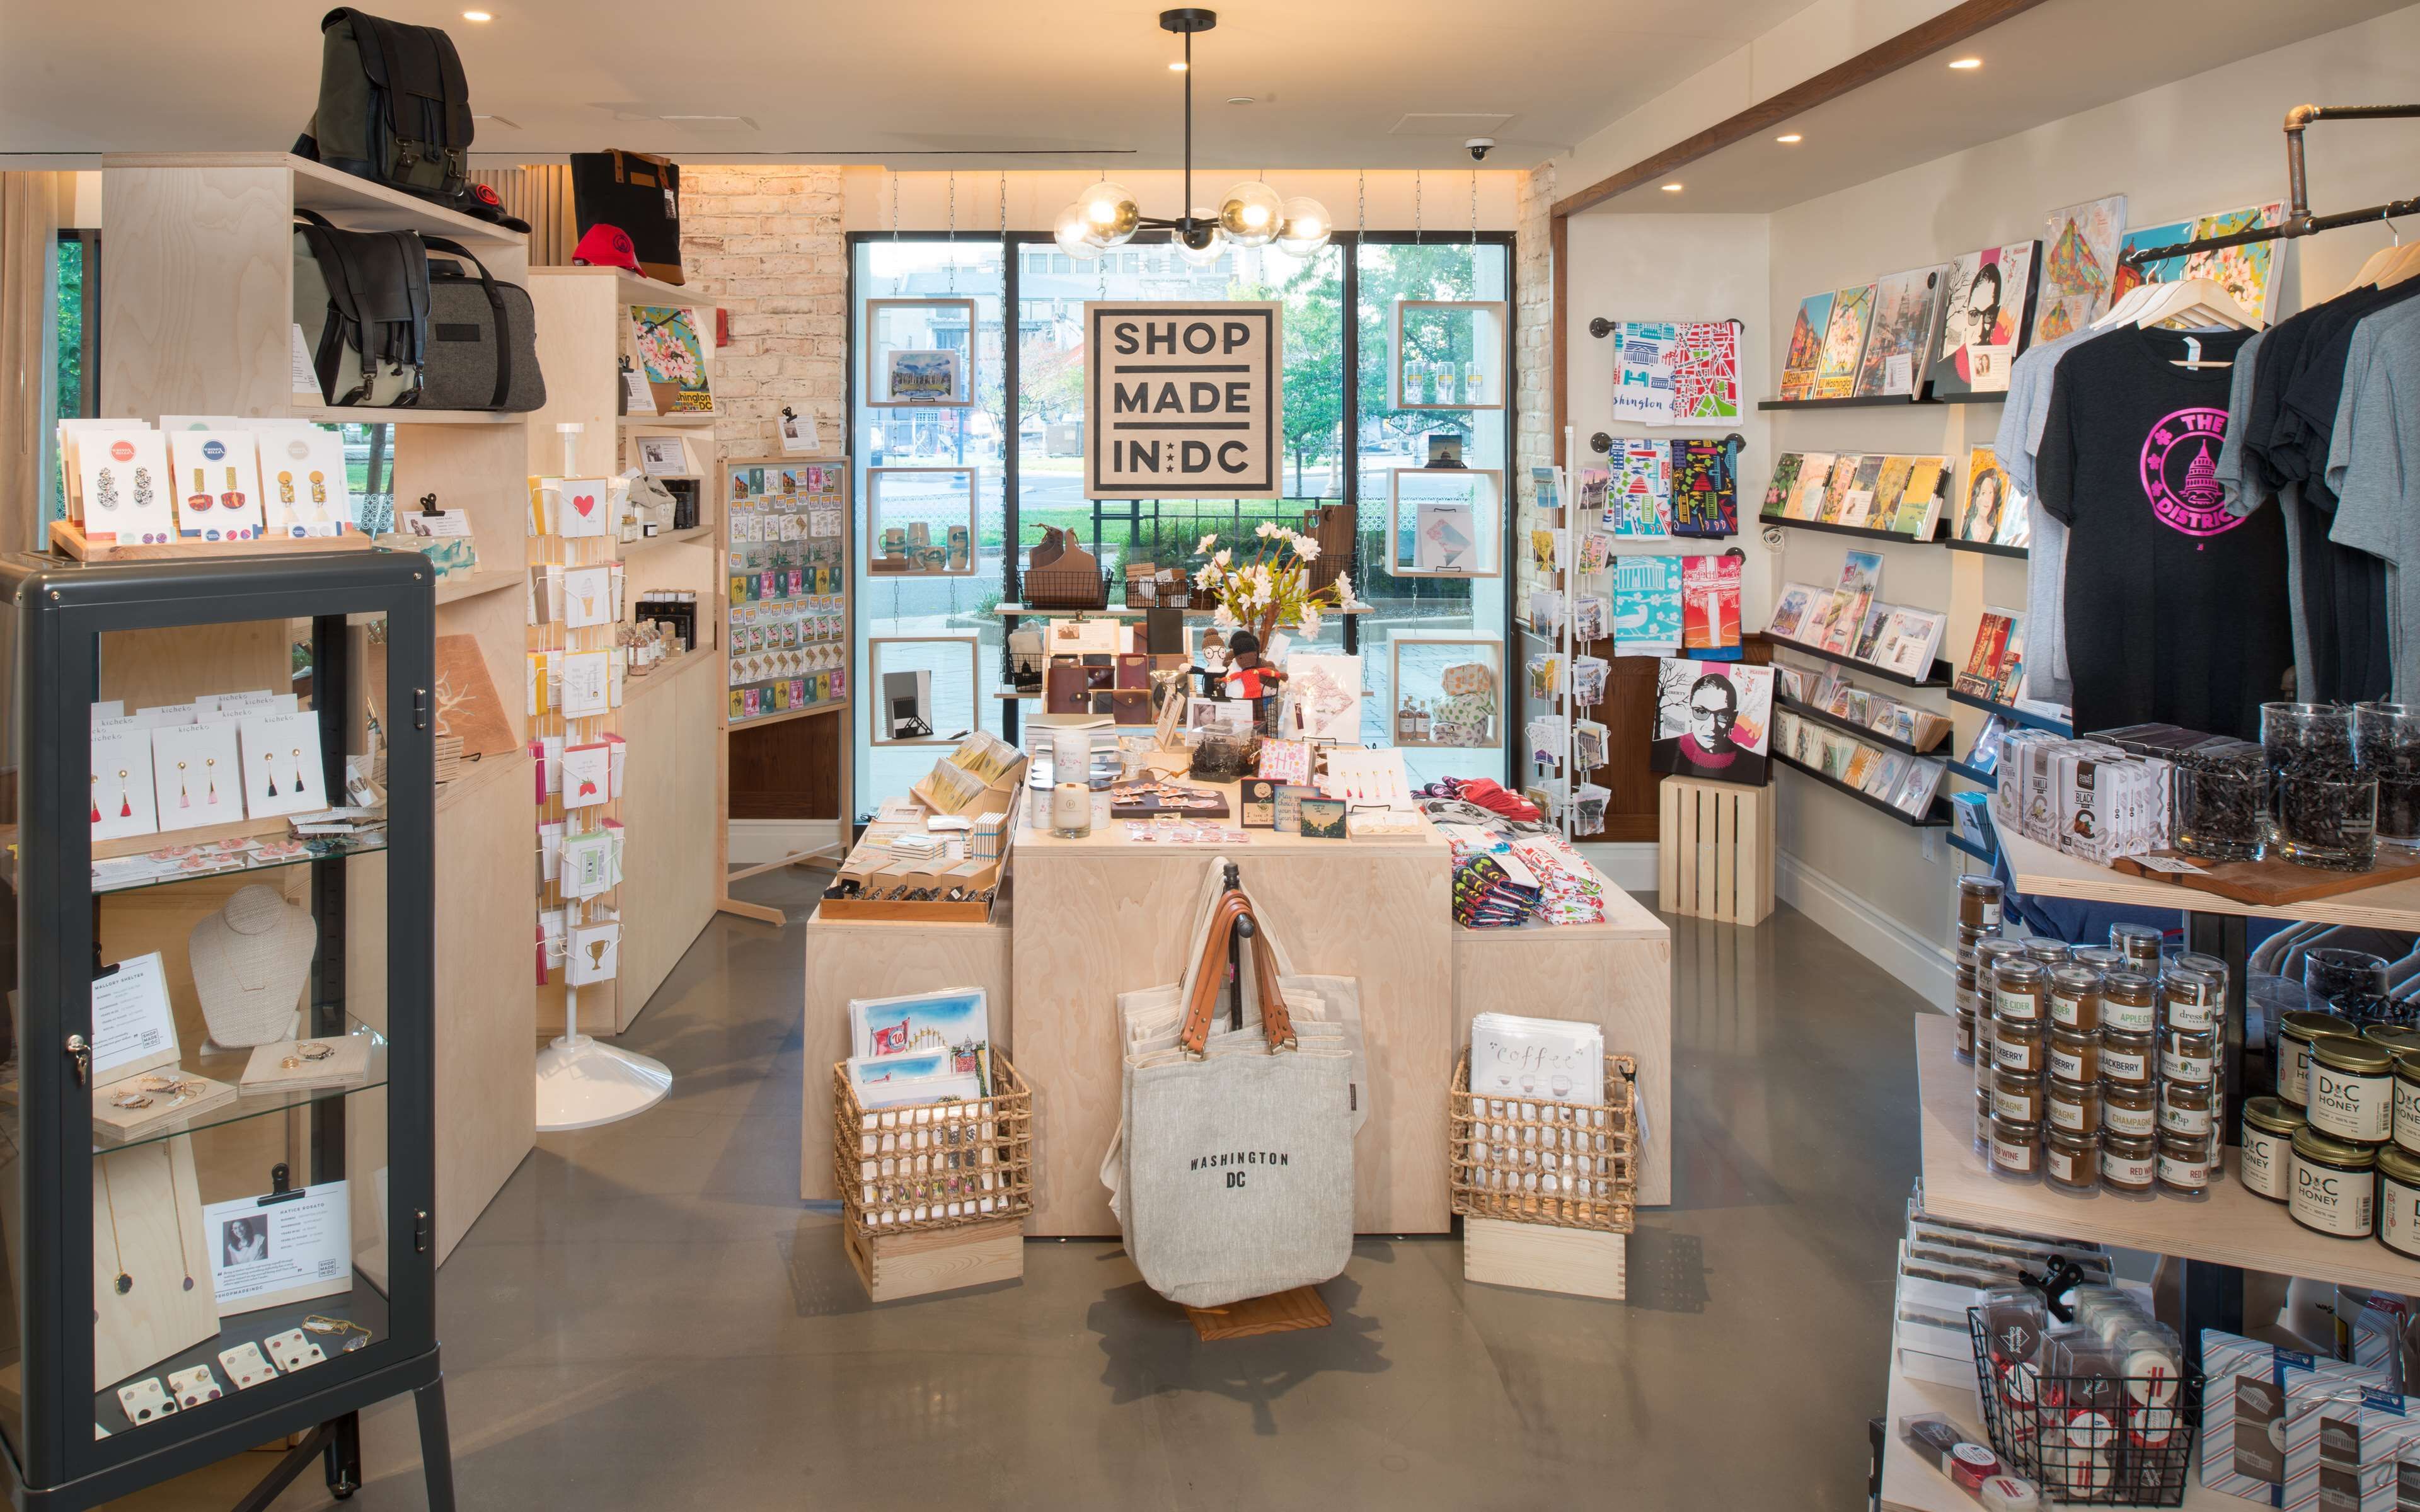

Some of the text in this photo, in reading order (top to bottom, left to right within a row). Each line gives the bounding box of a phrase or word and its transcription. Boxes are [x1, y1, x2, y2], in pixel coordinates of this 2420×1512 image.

[1114, 322, 1250, 355] SHOP
[676, 393, 711, 403] shington
[1114, 382, 1250, 413] MADE
[1613, 394, 1662, 410] shington
[699, 401, 713, 410] DC
[2180, 415, 2225, 433] THE
[1114, 440, 1249, 474] IN DC
[2156, 497, 2233, 528] DISTRIC
[1275, 752, 1293, 770] Hi
[2032, 779, 2048, 789] VANILLA
[2076, 792, 2095, 805] BLACK
[94, 972, 144, 990] MALLORY SHELTER
[2009, 1000, 2030, 1010] CIDER
[2120, 1013, 2142, 1024] APPLE
[2179, 1010, 2203, 1021] dress
[2190, 1065, 2200, 1076] up
[2319, 1094, 2360, 1113] HONEY
[2112, 1113, 2152, 1126] CHAMPAGNE
[2178, 1115, 2189, 1126] up
[2396, 1108, 2420, 1125] HONE
[1191, 1152, 1288, 1171] WASHINGTON
[2002, 1149, 2019, 1160] WINE
[2129, 1167, 2143, 1176] RED
[2190, 1170, 2202, 1179] RED
[1226, 1171, 1245, 1188] DC
[2299, 1188, 2339, 1206] HONEY
